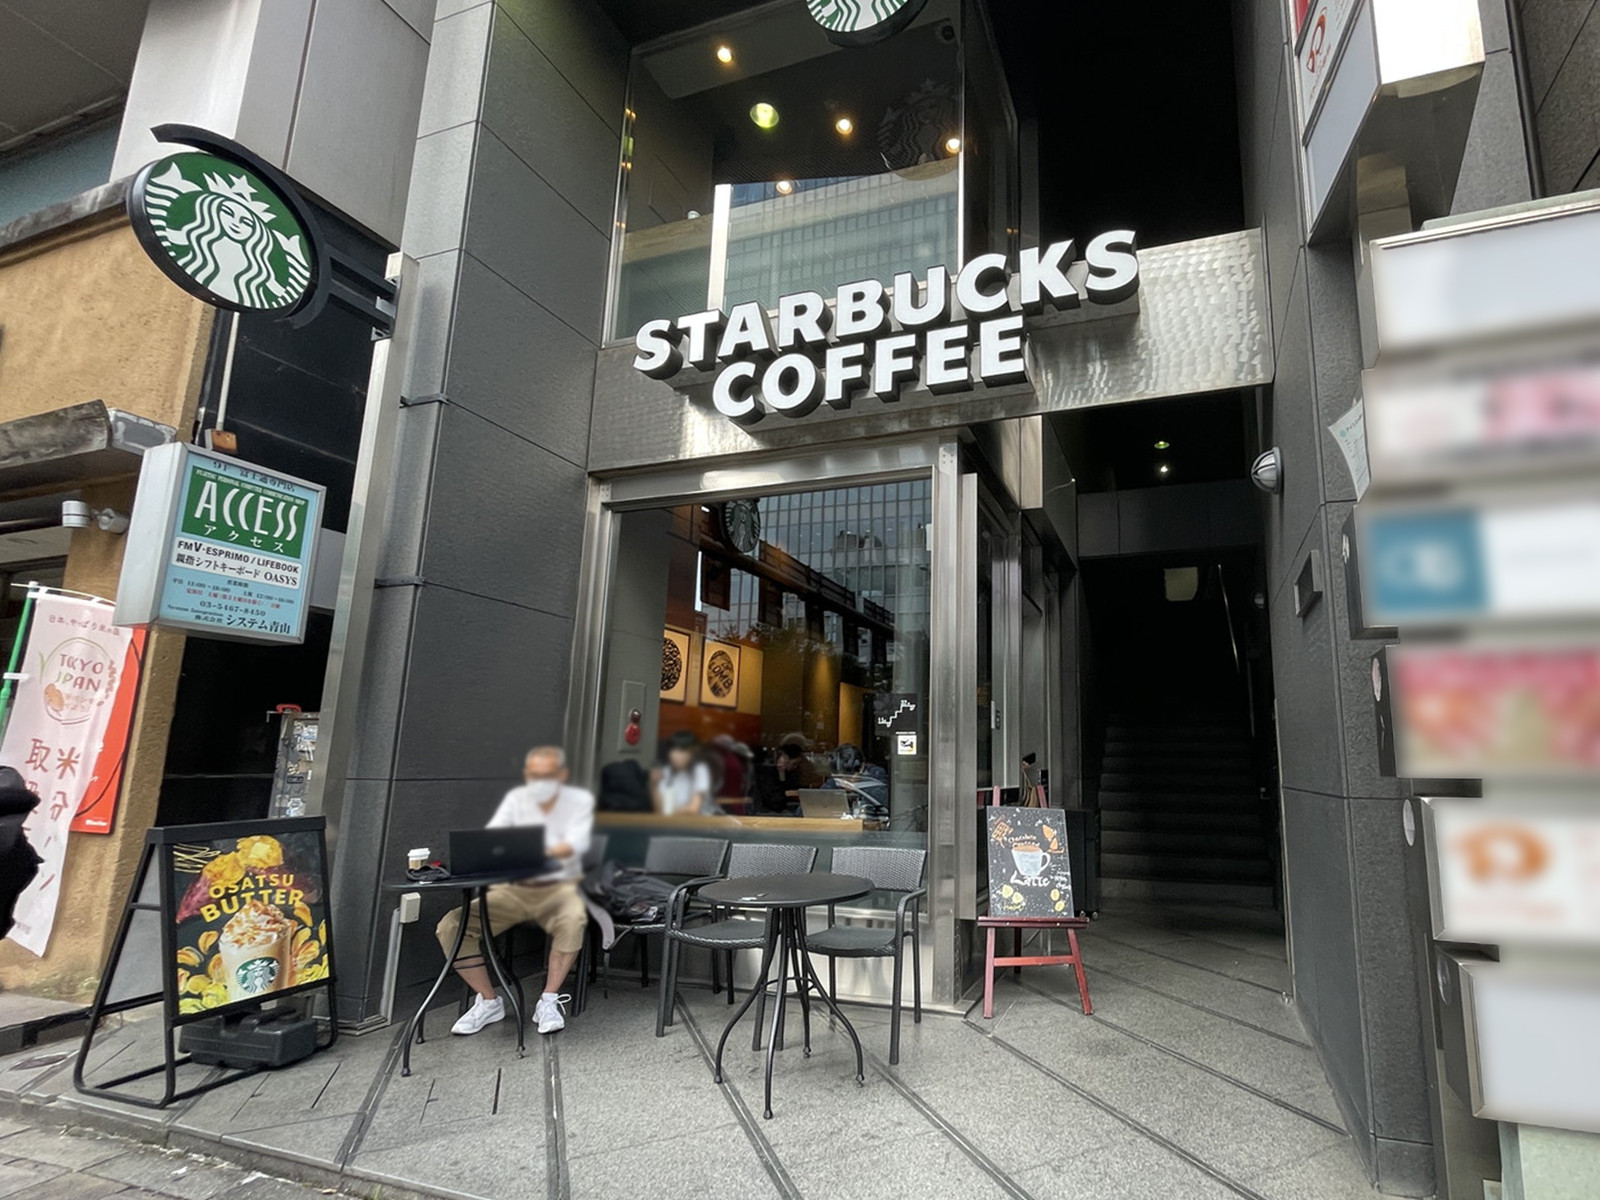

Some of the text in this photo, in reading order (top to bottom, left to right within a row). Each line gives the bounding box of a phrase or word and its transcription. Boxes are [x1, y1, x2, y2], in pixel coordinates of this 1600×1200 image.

[633, 229, 1139, 373] STARBUCKS
[712, 315, 1025, 418] COFFEE
[194, 480, 299, 542] ACCESS
[203, 524, 284, 553] アクセス
[257, 557, 299, 573] LIFEBOOK
[263, 571, 298, 586] OASYS
[226, 614, 291, 635] システム青山
[208, 873, 295, 899] OSATSU
[1010, 870, 1051, 887] Latte
[200, 888, 304, 923] BUTTER
